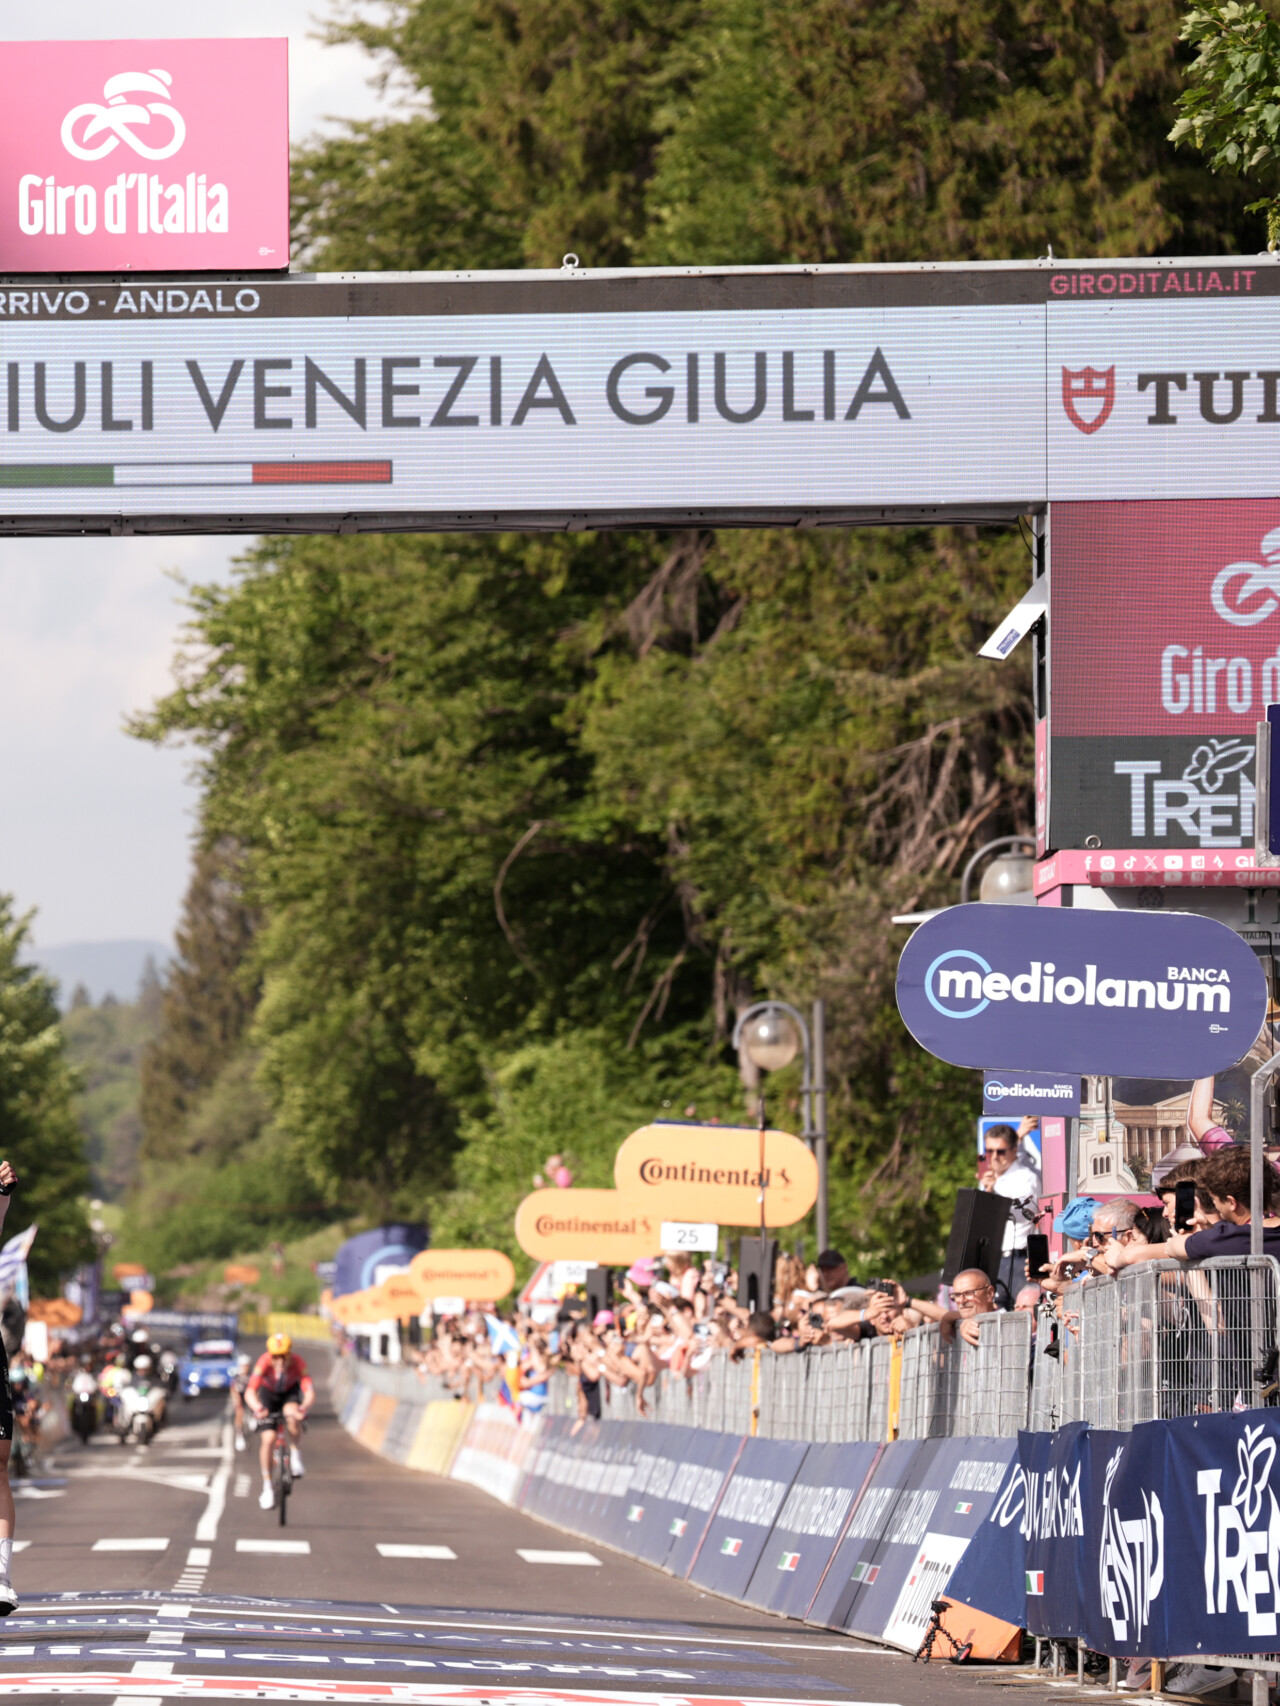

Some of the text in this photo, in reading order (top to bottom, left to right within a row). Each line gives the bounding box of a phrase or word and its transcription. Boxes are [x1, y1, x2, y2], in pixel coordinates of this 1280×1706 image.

[18, 171, 229, 236] Giro d'Italia
[1049, 270, 1257, 295] GIRODITALIA.IT
[113, 288, 260, 314] ANDALO
[185, 351, 578, 435] VENEZIA
[605, 347, 913, 425] GIULIA
[1161, 644, 1253, 715] Giro
[938, 961, 1231, 1013] mediolanum
[1167, 965, 1230, 984] BANCA
[987, 1083, 1074, 1099] mediolanum
[639, 1156, 771, 1189] Continental
[534, 1213, 637, 1237] Continental
[677, 1228, 700, 1245] 25
[183, 1619, 483, 1642] VENEZIA
[500, 1637, 736, 1658] GIULIA
